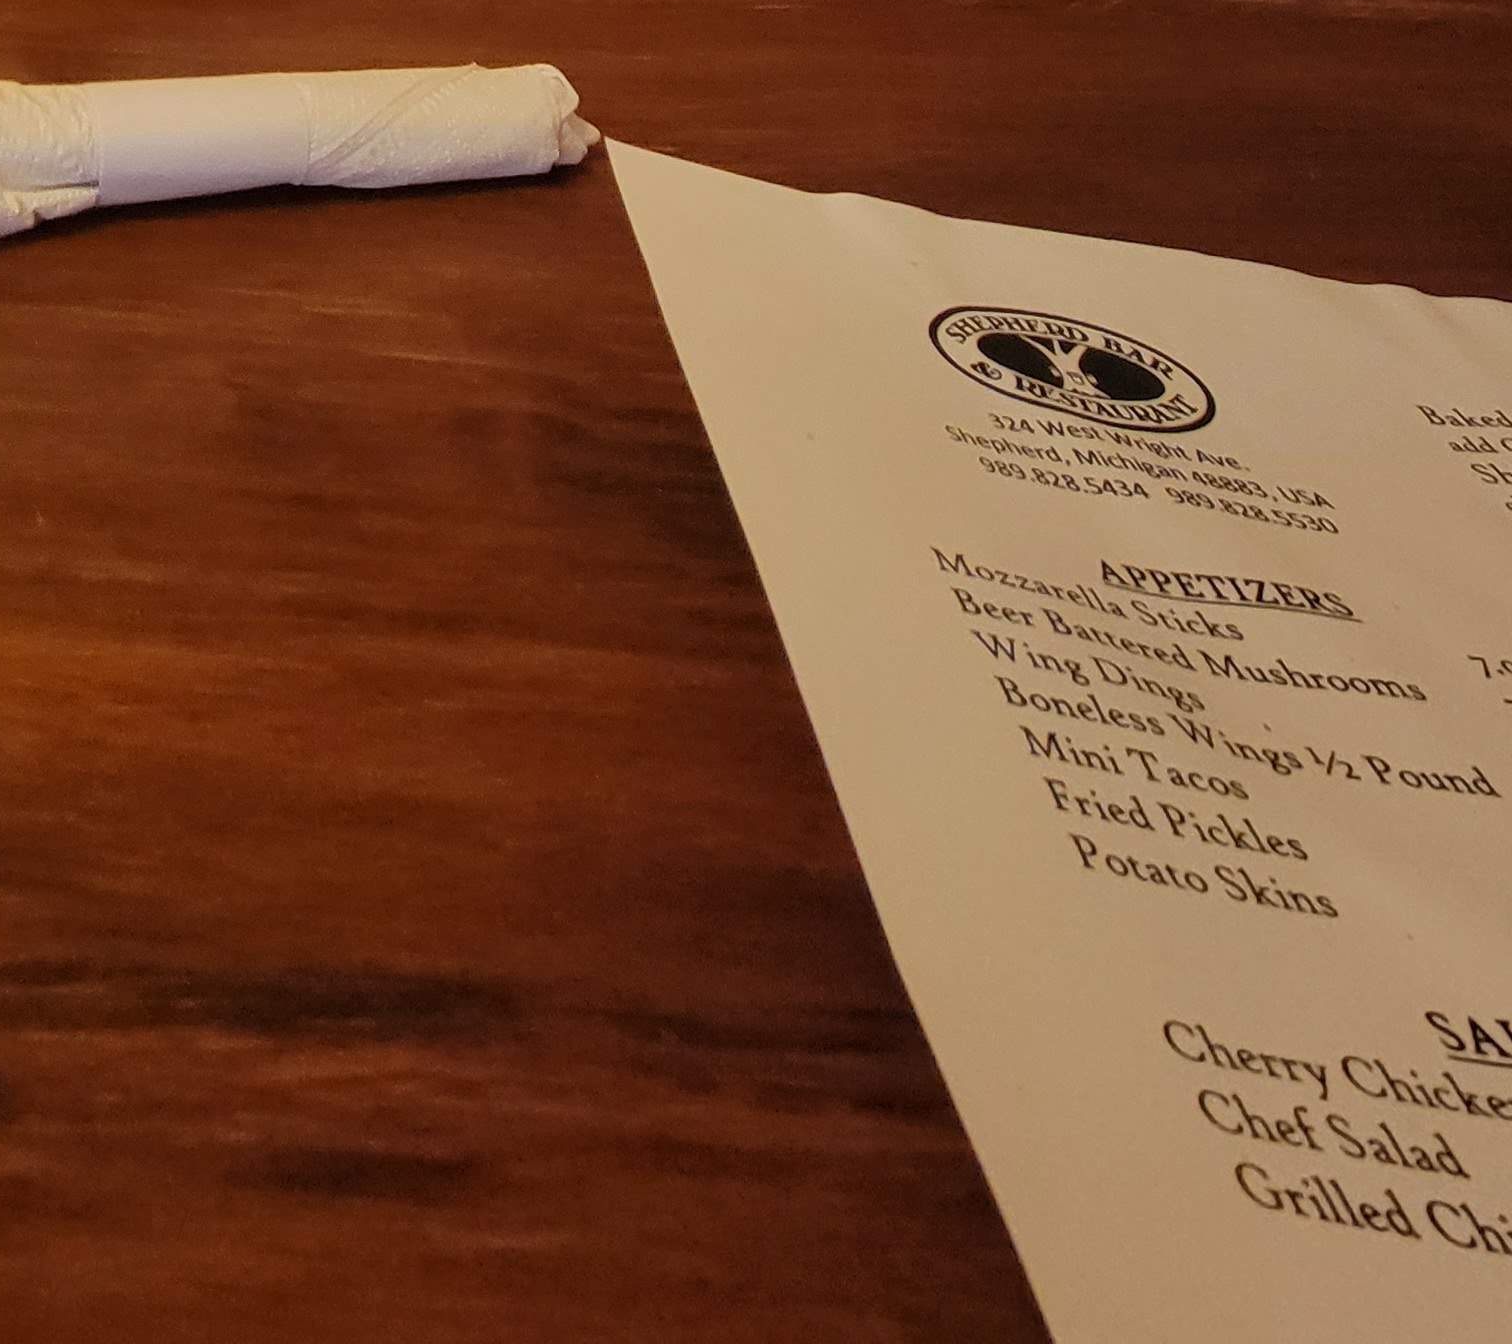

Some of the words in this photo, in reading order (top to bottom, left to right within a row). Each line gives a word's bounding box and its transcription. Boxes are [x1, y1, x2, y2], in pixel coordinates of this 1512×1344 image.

[945, 315, 1089, 344] SHEPHERD
[1101, 335, 1174, 381] BAR
[970, 360, 1003, 381] &
[1014, 375, 1198, 424] RESTAURANT
[1415, 404, 1512, 428] Baked
[944, 424, 1071, 467] Shepherd,
[1073, 448, 1188, 483] Michigan
[1191, 470, 1278, 503] 48883,
[1276, 486, 1336, 510] USA
[989, 413, 1035, 434] 324
[1037, 419, 1101, 442] West
[1105, 429, 1192, 462] Wright
[1195, 448, 1252, 473] Ave.
[1448, 435, 1500, 454] add
[978, 456, 1151, 500] 989.828.5434
[1163, 485, 1340, 535] 989.828.5530
[930, 545, 1123, 617] Mozzarella
[1131, 599, 1245, 641] Sticks
[1099, 559, 1354, 618] APPETIZERS
[952, 586, 1034, 627] Beer
[1041, 608, 1198, 673] Battered
[1197, 649, 1428, 702] Mushrooms
[971, 629, 1090, 687] Wing
[1090, 656, 1206, 713] Dings
[994, 675, 1166, 737] Boneless
[1167, 713, 1304, 776] Wings
[1359, 753, 1503, 799] Pound
[1018, 724, 1125, 775] Mini
[1125, 746, 1250, 801] Tacos
[1044, 777, 1154, 832] Fried
[1156, 802, 1309, 862] Pickles
[1069, 832, 1209, 894] Potato
[1213, 865, 1339, 918] Skins
[1163, 1019, 1330, 1101] Cherry
[1197, 1089, 1322, 1152] Chef
[1324, 1115, 1470, 1180] Salad
[1235, 1162, 1422, 1240] Grilled
